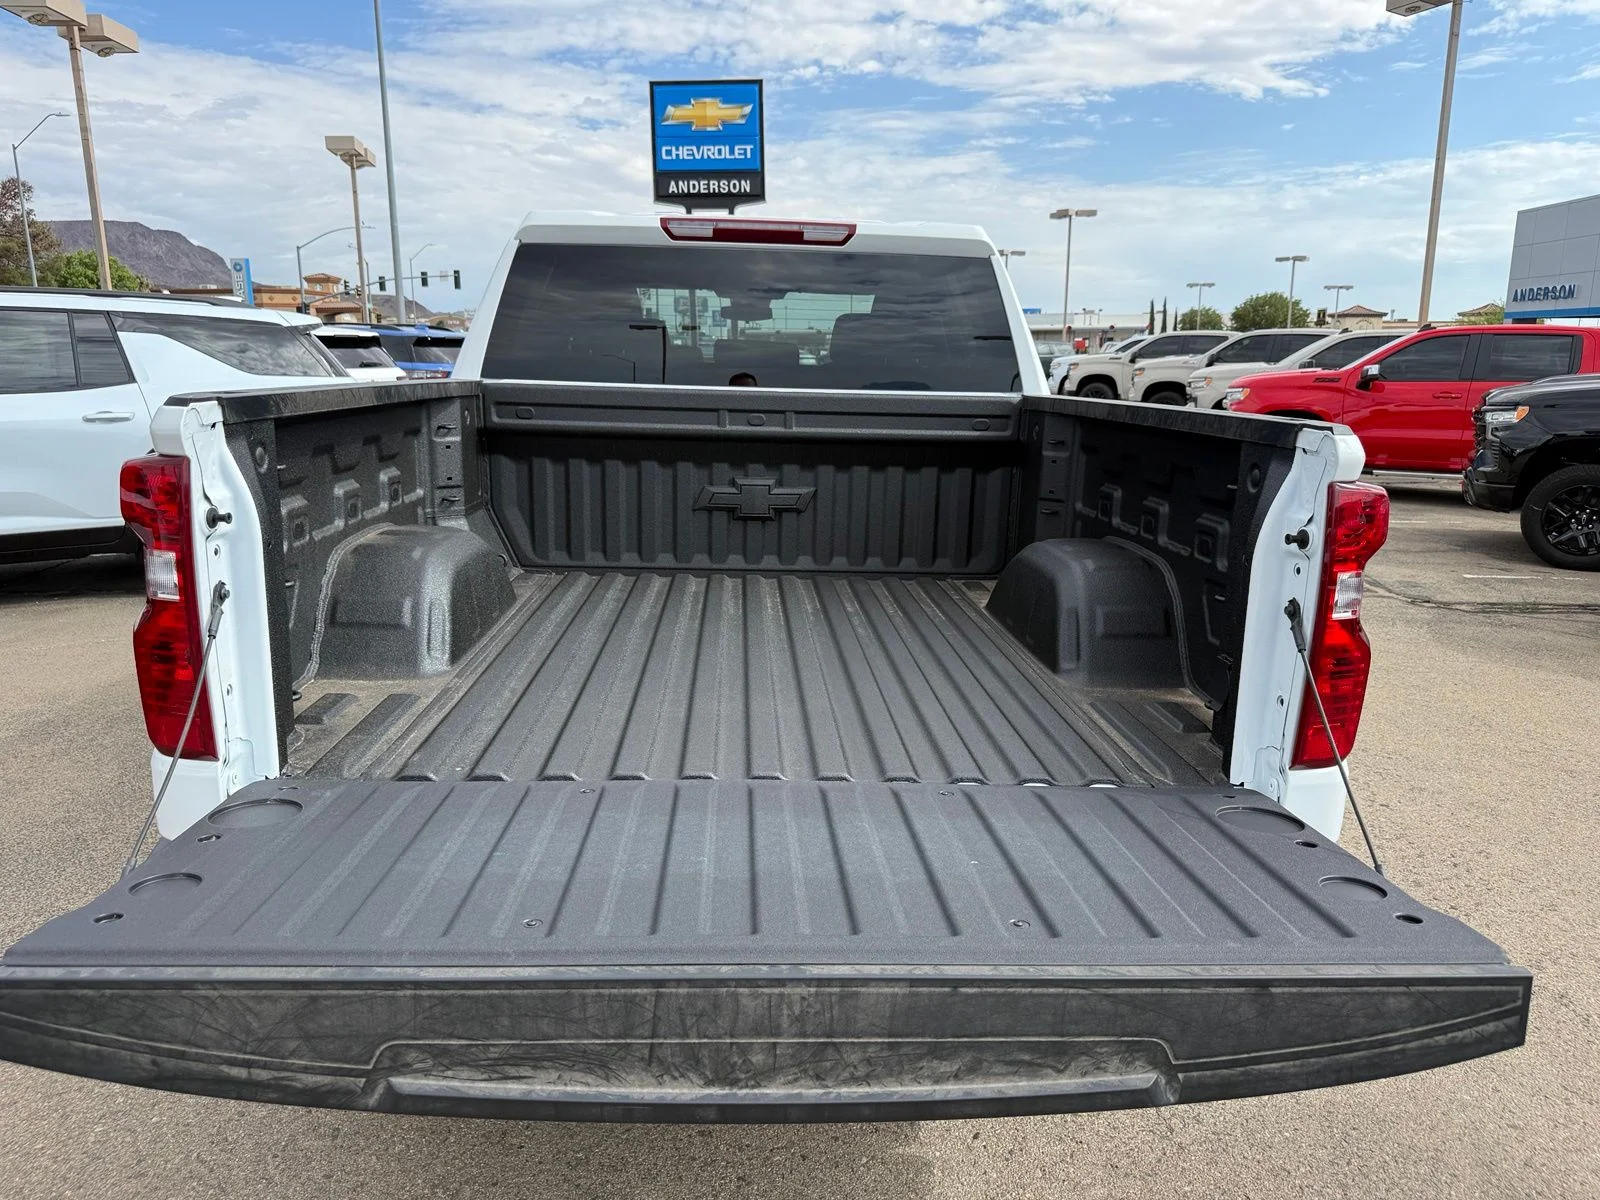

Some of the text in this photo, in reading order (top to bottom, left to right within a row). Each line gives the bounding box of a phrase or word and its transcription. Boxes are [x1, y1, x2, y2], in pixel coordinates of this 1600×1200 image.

[661, 145, 754, 160] CHEVROLET
[668, 180, 751, 194] ANDERSON
[1512, 284, 1576, 302] ANDERSON
